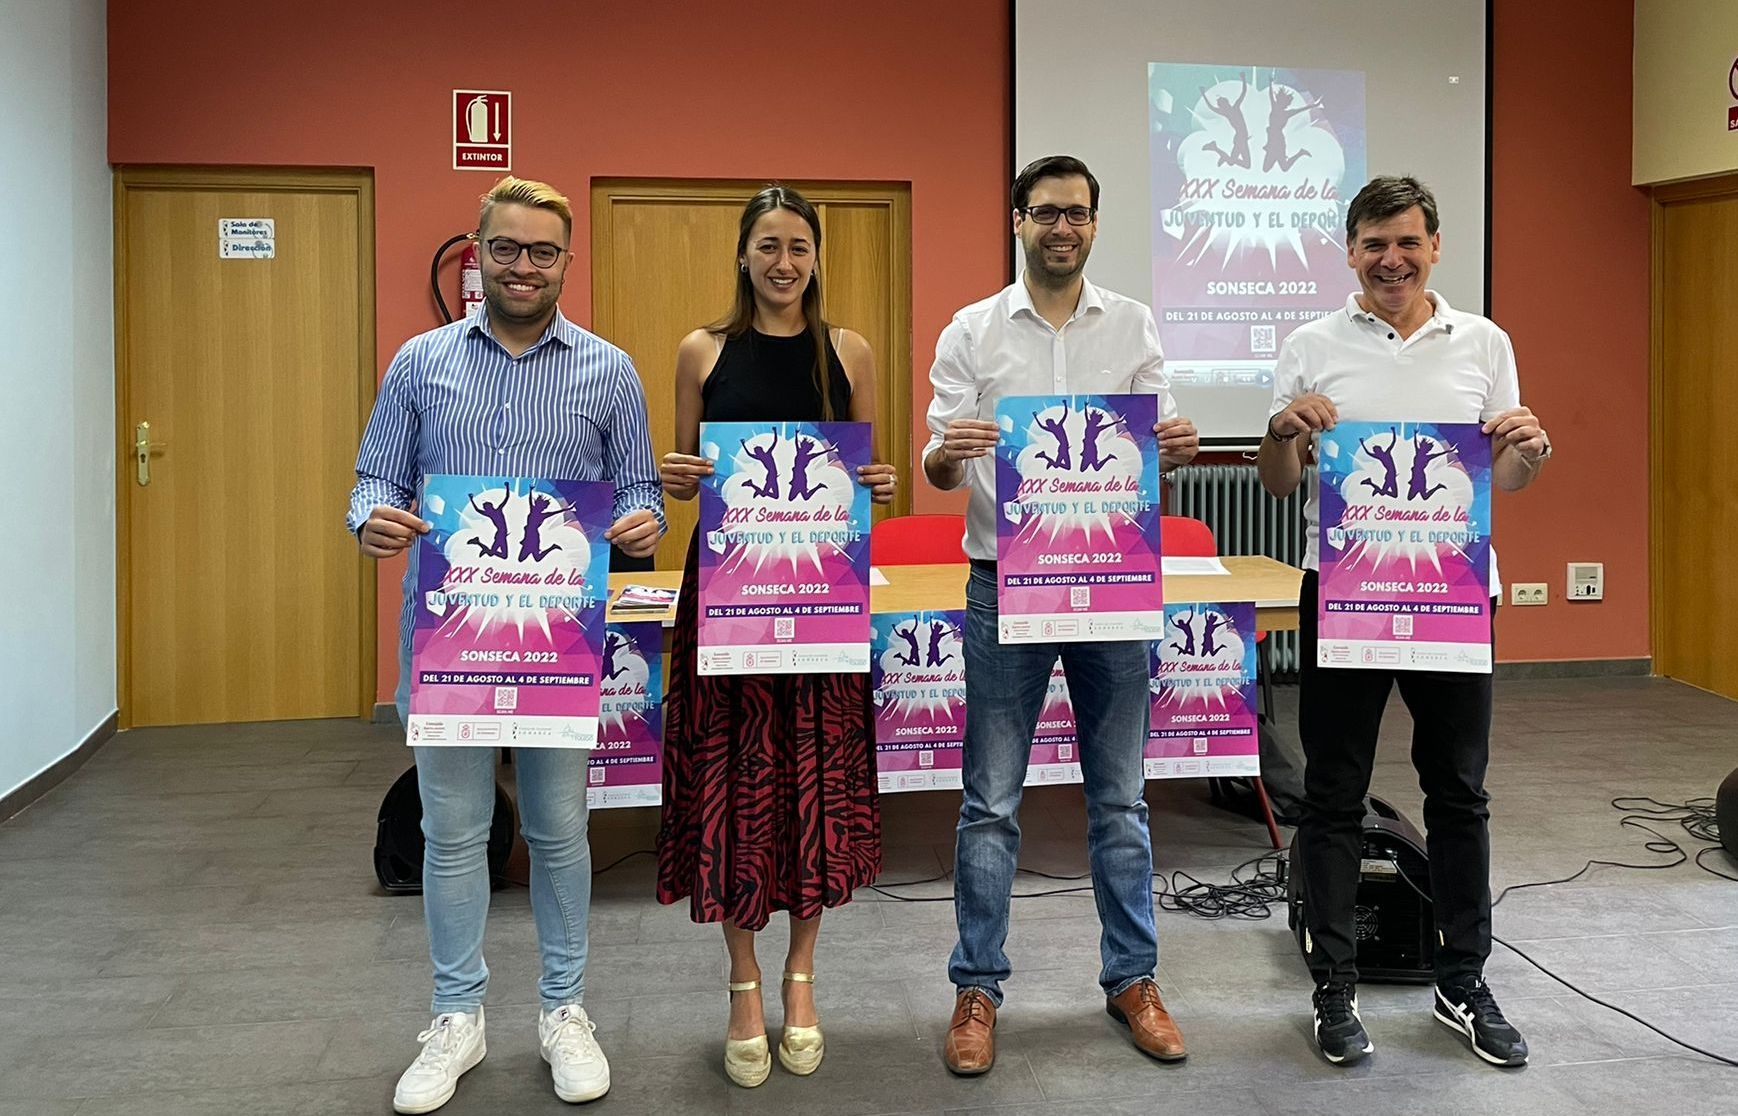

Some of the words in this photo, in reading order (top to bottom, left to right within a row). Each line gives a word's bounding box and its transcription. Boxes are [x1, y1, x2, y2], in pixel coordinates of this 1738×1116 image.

[462, 153, 503, 161] EXTINTOR
[1179, 178, 1220, 200] XXX
[1222, 178, 1291, 200] Semana
[1294, 178, 1317, 200] de
[1321, 178, 1340, 200] la
[1164, 210, 1246, 228] JUVENTUD
[1253, 212, 1262, 228] Y
[1268, 212, 1284, 228] EL
[1291, 210, 1339, 228] DEPOR
[1207, 282, 1276, 295] SONSECA
[1279, 282, 1317, 295] 2022
[1166, 312, 1184, 321] DEL
[1187, 312, 1198, 321] 21
[1202, 312, 1214, 321] DE
[1216, 312, 1259, 321] AGOSTO
[1261, 312, 1273, 321] AL
[1276, 312, 1282, 321] 4
[1285, 311, 1296, 321] DE
[1018, 479, 1048, 494] XXX
[1049, 478, 1102, 493] Semana
[1104, 476, 1122, 492] de
[1125, 476, 1139, 492] la
[1006, 502, 1067, 515] JUVENTUD
[1072, 502, 1079, 514] Y
[1084, 502, 1096, 514] EL
[1102, 500, 1151, 514] DEPORTE
[722, 508, 754, 523] XXX
[756, 507, 810, 523] Semana
[813, 505, 832, 522] de
[834, 505, 850, 521] la
[1342, 506, 1373, 521] XXX
[1375, 506, 1430, 521] Semana
[1432, 506, 1450, 522] de
[1454, 506, 1469, 522] la
[710, 532, 773, 545] JUVENTUD
[779, 532, 787, 544] Y
[792, 531, 804, 544] EL
[810, 530, 860, 544] DEPORTE
[1330, 529, 1392, 542] JUVENTUD
[1398, 530, 1406, 542] Y
[1410, 530, 1424, 543] EL
[1429, 530, 1480, 544] DEPORTE
[1038, 554, 1090, 565] SONSECA
[1092, 553, 1122, 563] 2022
[443, 567, 479, 583] XXX
[481, 567, 542, 585] Semana
[545, 568, 566, 586] de
[568, 568, 585, 586] la
[1034, 577, 1043, 585] DE
[1045, 576, 1076, 584] AGOSTO
[1108, 574, 1152, 582] SEPTIEMBRE
[742, 584, 796, 596] SONSECA
[799, 583, 830, 594] 2022
[1360, 581, 1414, 592] SONSECA
[1417, 582, 1448, 593] 2022
[429, 592, 499, 607] JUVENTUD
[506, 594, 514, 607] Y
[520, 595, 533, 608] EL
[540, 595, 595, 609] DEPORTE
[709, 608, 724, 616] DEL
[726, 608, 735, 616] 21
[748, 607, 781, 615] AGOSTO
[802, 606, 812, 614] DE
[814, 606, 859, 614] SEPTIEMBRE
[1367, 604, 1399, 612] AGOSTO
[1401, 604, 1412, 612] AL
[1432, 605, 1479, 613] SEPTIEMBRE
[461, 651, 521, 662] SONSECA
[524, 652, 559, 663] 2022
[1158, 662, 1178, 673] XXX
[1180, 661, 1217, 672] Semana
[1218, 660, 1230, 671] de
[1232, 659, 1241, 671] la
[423, 674, 439, 682] DEL
[442, 674, 452, 682] 21
[453, 675, 465, 683] DE
[467, 675, 505, 683] AGOSTO
[506, 675, 517, 683] AL
[519, 676, 524, 684] 4
[526, 676, 537, 684] DE
[540, 676, 590, 685] SEPTIEMBRE
[882, 673, 903, 685] XXX
[904, 672, 943, 683] Semana
[945, 670, 958, 682] de
[960, 670, 965, 681] l
[1196, 679, 1202, 687] Y
[1204, 679, 1212, 687] EL
[619, 683, 633, 695] de
[634, 682, 646, 695] la
[920, 690, 926, 698] Y
[930, 689, 939, 698] EL
[602, 703, 612, 713] EL
[1171, 715, 1208, 723] SONSECA
[1209, 714, 1230, 722] 2022
[896, 727, 934, 736] SONSECA
[935, 726, 958, 734] 2022
[608, 741, 631, 749] 2022
